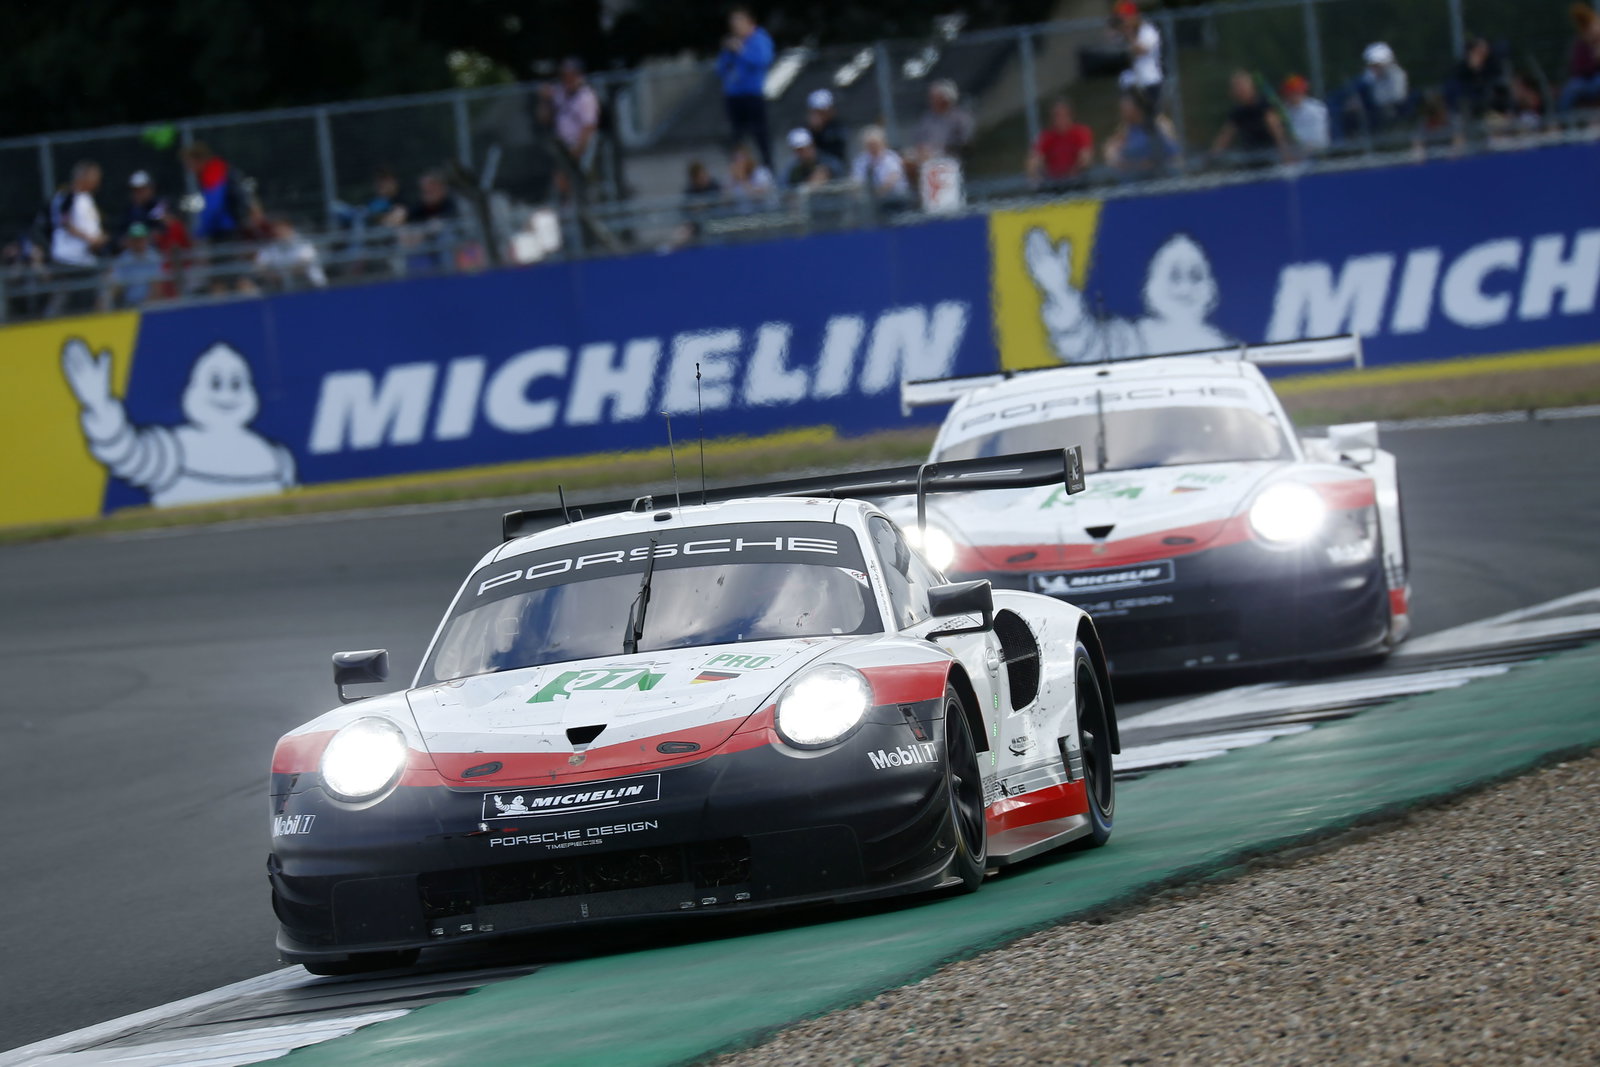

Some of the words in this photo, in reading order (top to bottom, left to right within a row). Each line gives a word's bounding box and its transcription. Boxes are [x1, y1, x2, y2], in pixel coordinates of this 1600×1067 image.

[1264, 228, 1600, 341] MICH
[308, 300, 969, 455] MICHELIN
[960, 386, 1249, 431] PORSCHE
[477, 537, 838, 596] PORSCHE
[707, 653, 772, 669] PRO
[867, 744, 923, 770] Mobil
[531, 785, 644, 808] MICHELIN
[490, 829, 581, 847] PORSCHE
[586, 820, 659, 837] DESIGN
